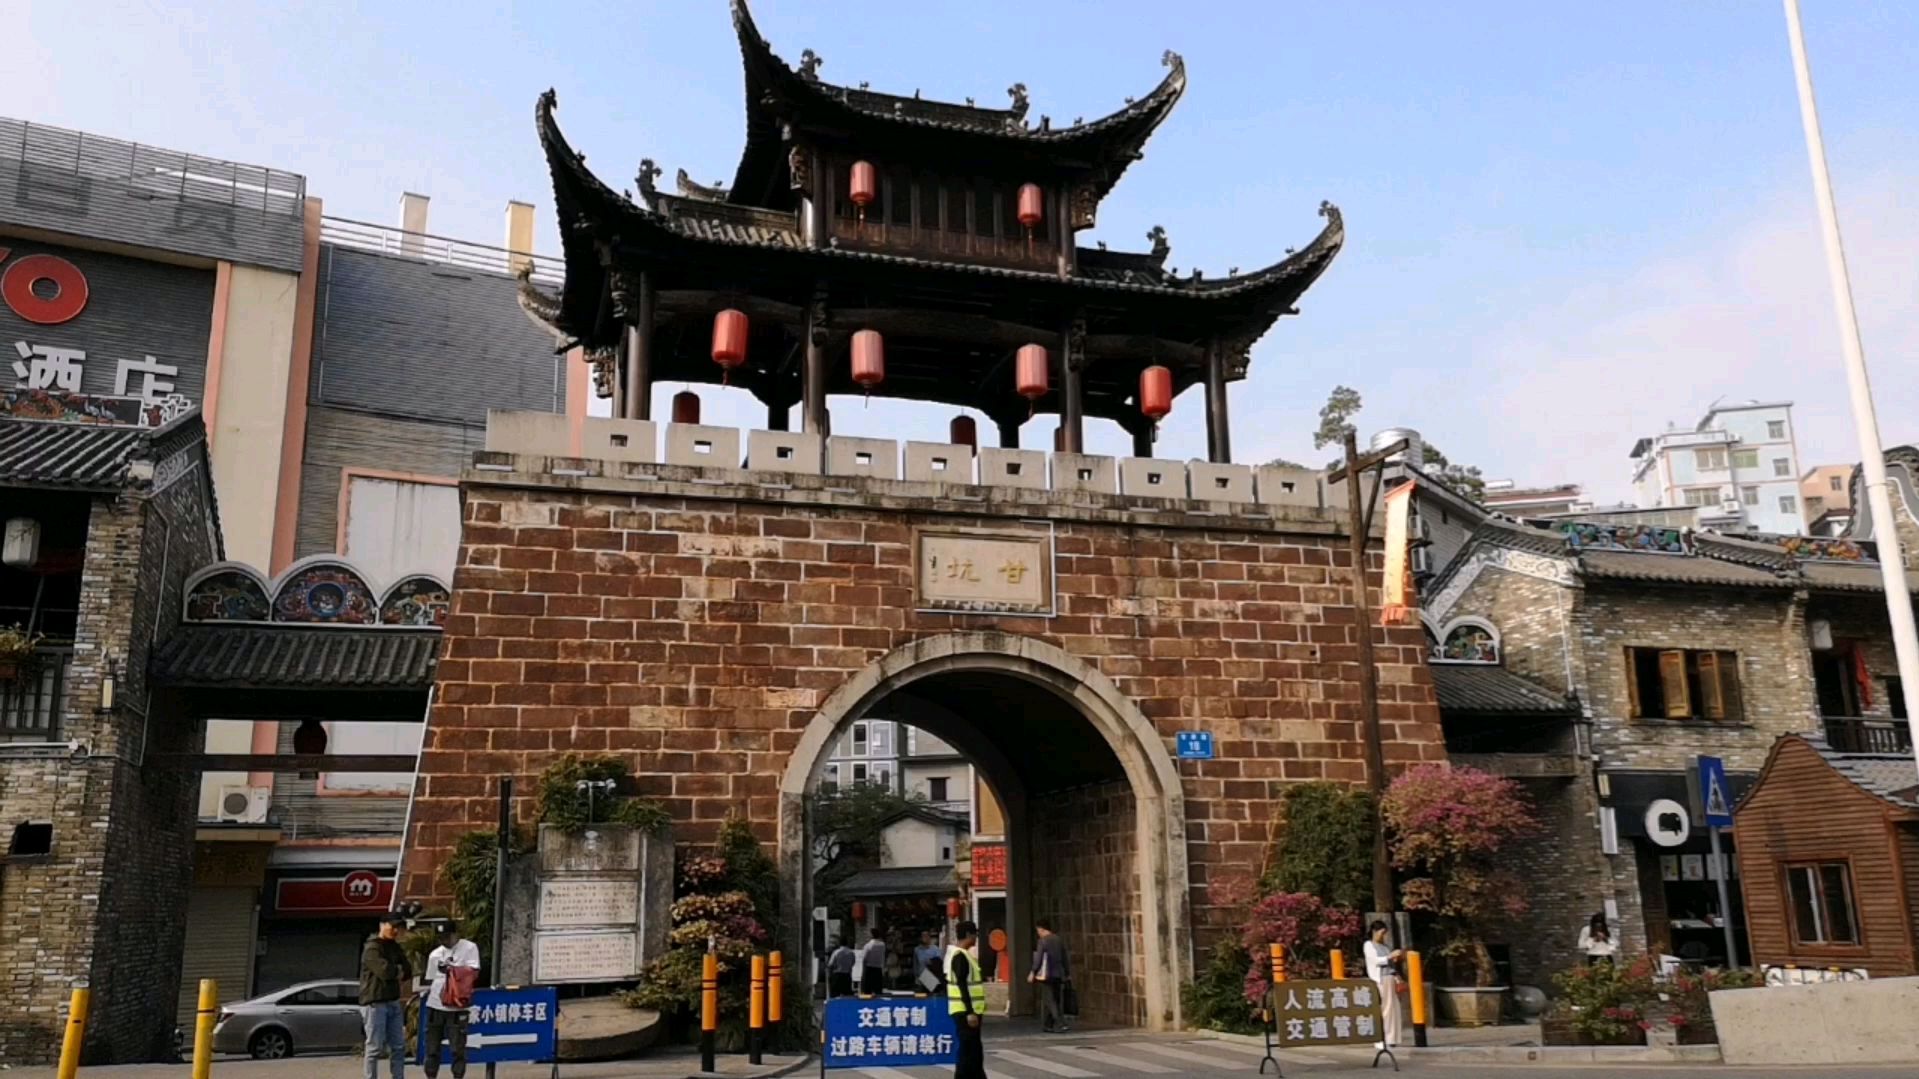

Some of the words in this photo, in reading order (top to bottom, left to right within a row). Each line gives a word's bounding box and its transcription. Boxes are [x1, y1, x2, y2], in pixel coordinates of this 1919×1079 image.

[1283, 986, 1373, 1010] 人流高峰
[857, 1006, 927, 1028] 交通管制
[1285, 1014, 1375, 1040] 交通管制
[830, 1034, 953, 1057] 过路车辆请绕行
